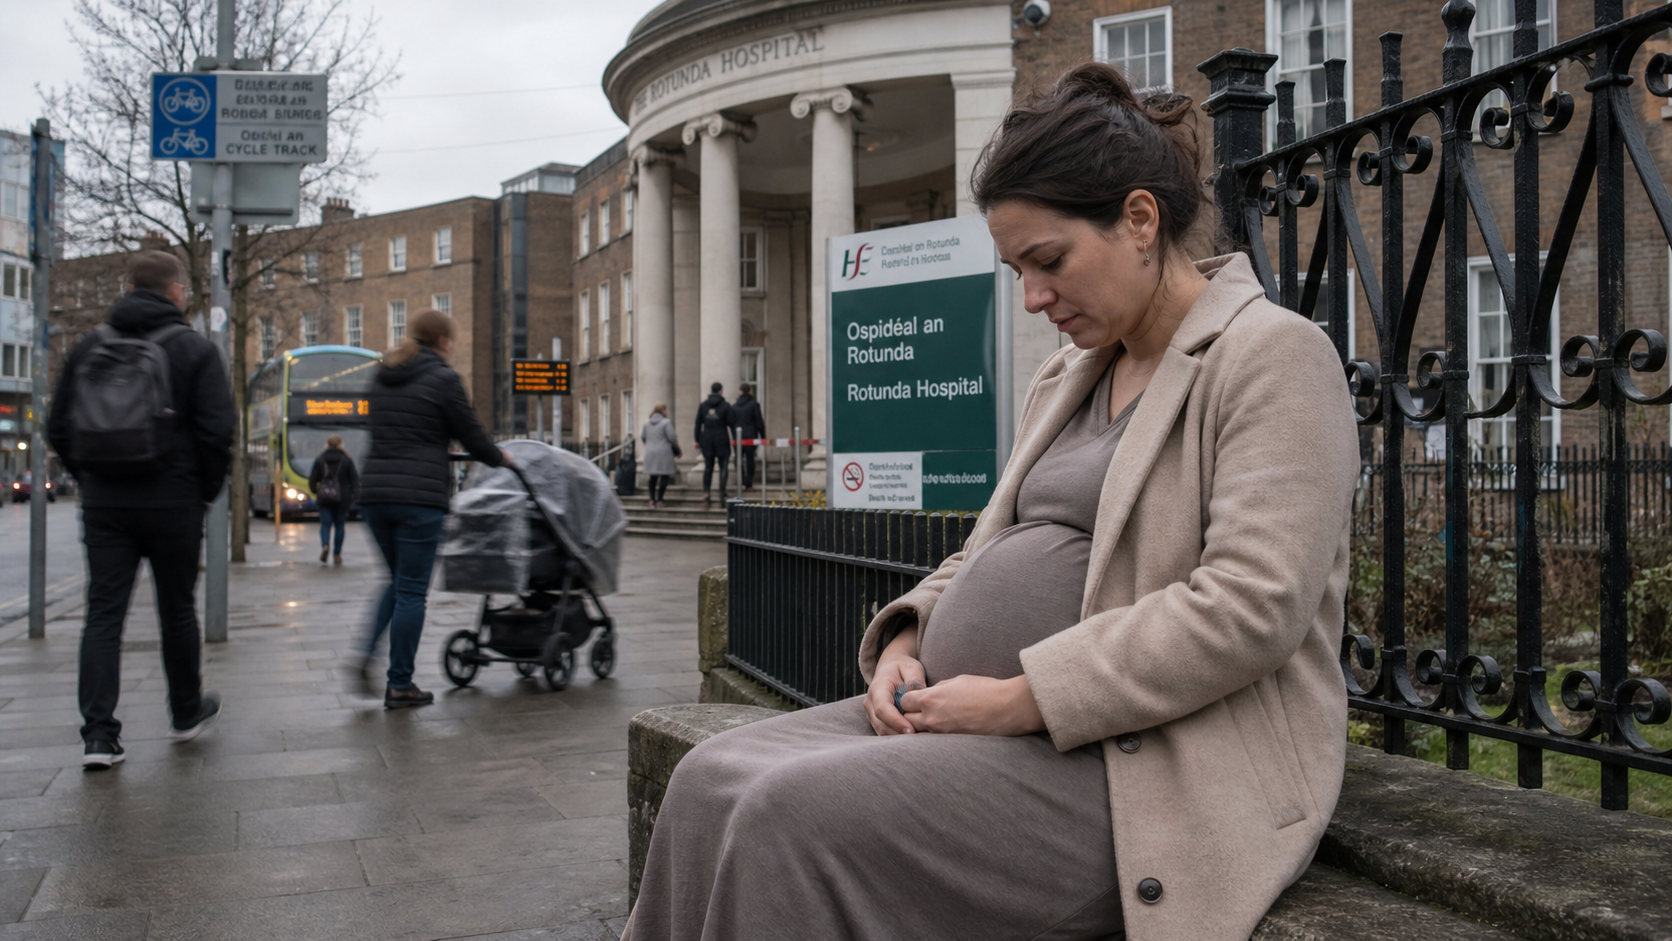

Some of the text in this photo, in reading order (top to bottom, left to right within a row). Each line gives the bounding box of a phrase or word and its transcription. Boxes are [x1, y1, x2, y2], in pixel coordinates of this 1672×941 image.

[650, 60, 712, 103] ROTUNDA
[720, 31, 825, 74] HOSPITAL
[226, 143, 317, 156] CYCLE TRACK
[847, 316, 944, 343] Ospidéal an
[848, 342, 914, 365] Rotunda
[848, 375, 983, 402] Rotunda Hospital
